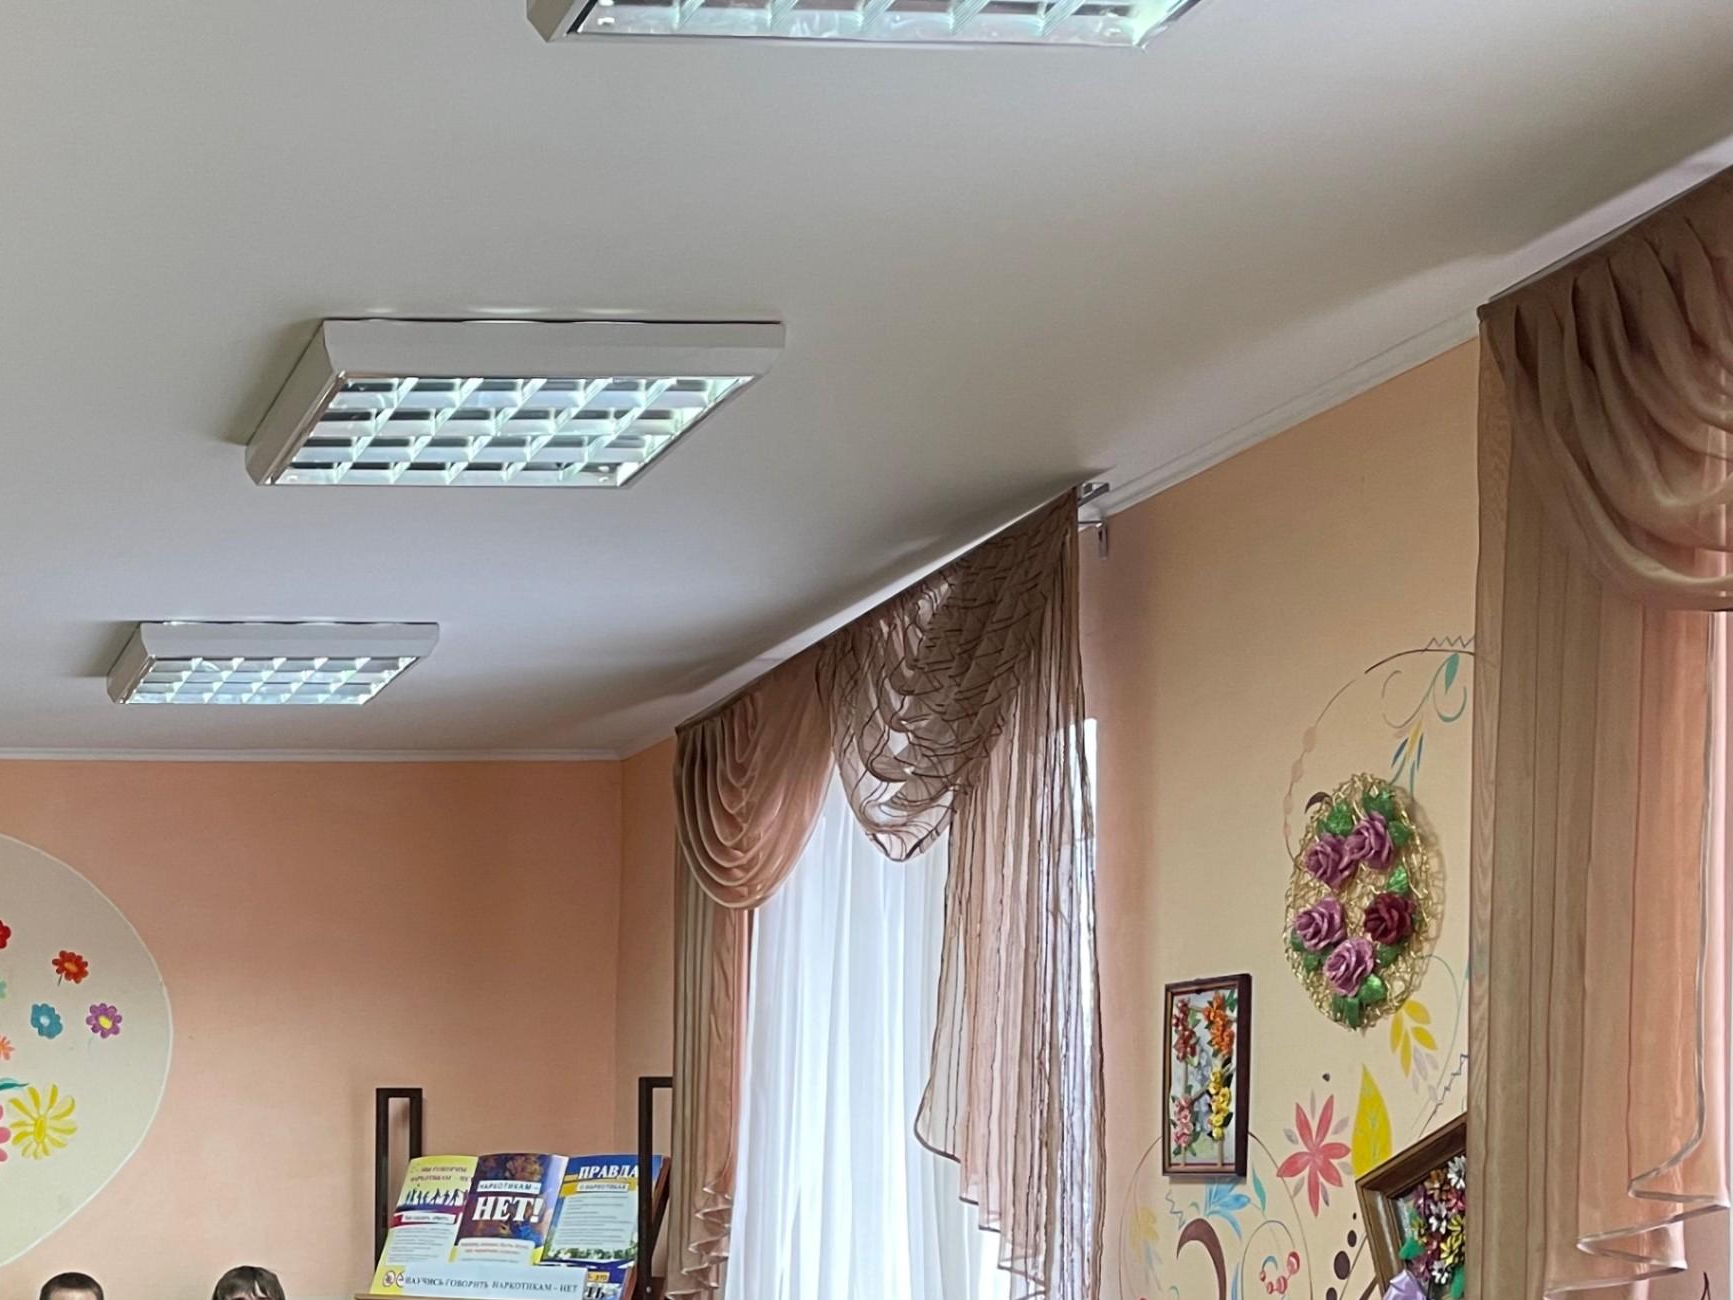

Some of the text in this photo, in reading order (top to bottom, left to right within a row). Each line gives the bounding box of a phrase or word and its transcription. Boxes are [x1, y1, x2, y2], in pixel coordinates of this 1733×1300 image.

[578, 1164, 639, 1180] ПРАВДА
[472, 1196, 545, 1223] НЕТ!
[445, 1278, 489, 1288] ГОВОРИТЬ
[491, 1280, 552, 1292] НАРКОТИКАМ
